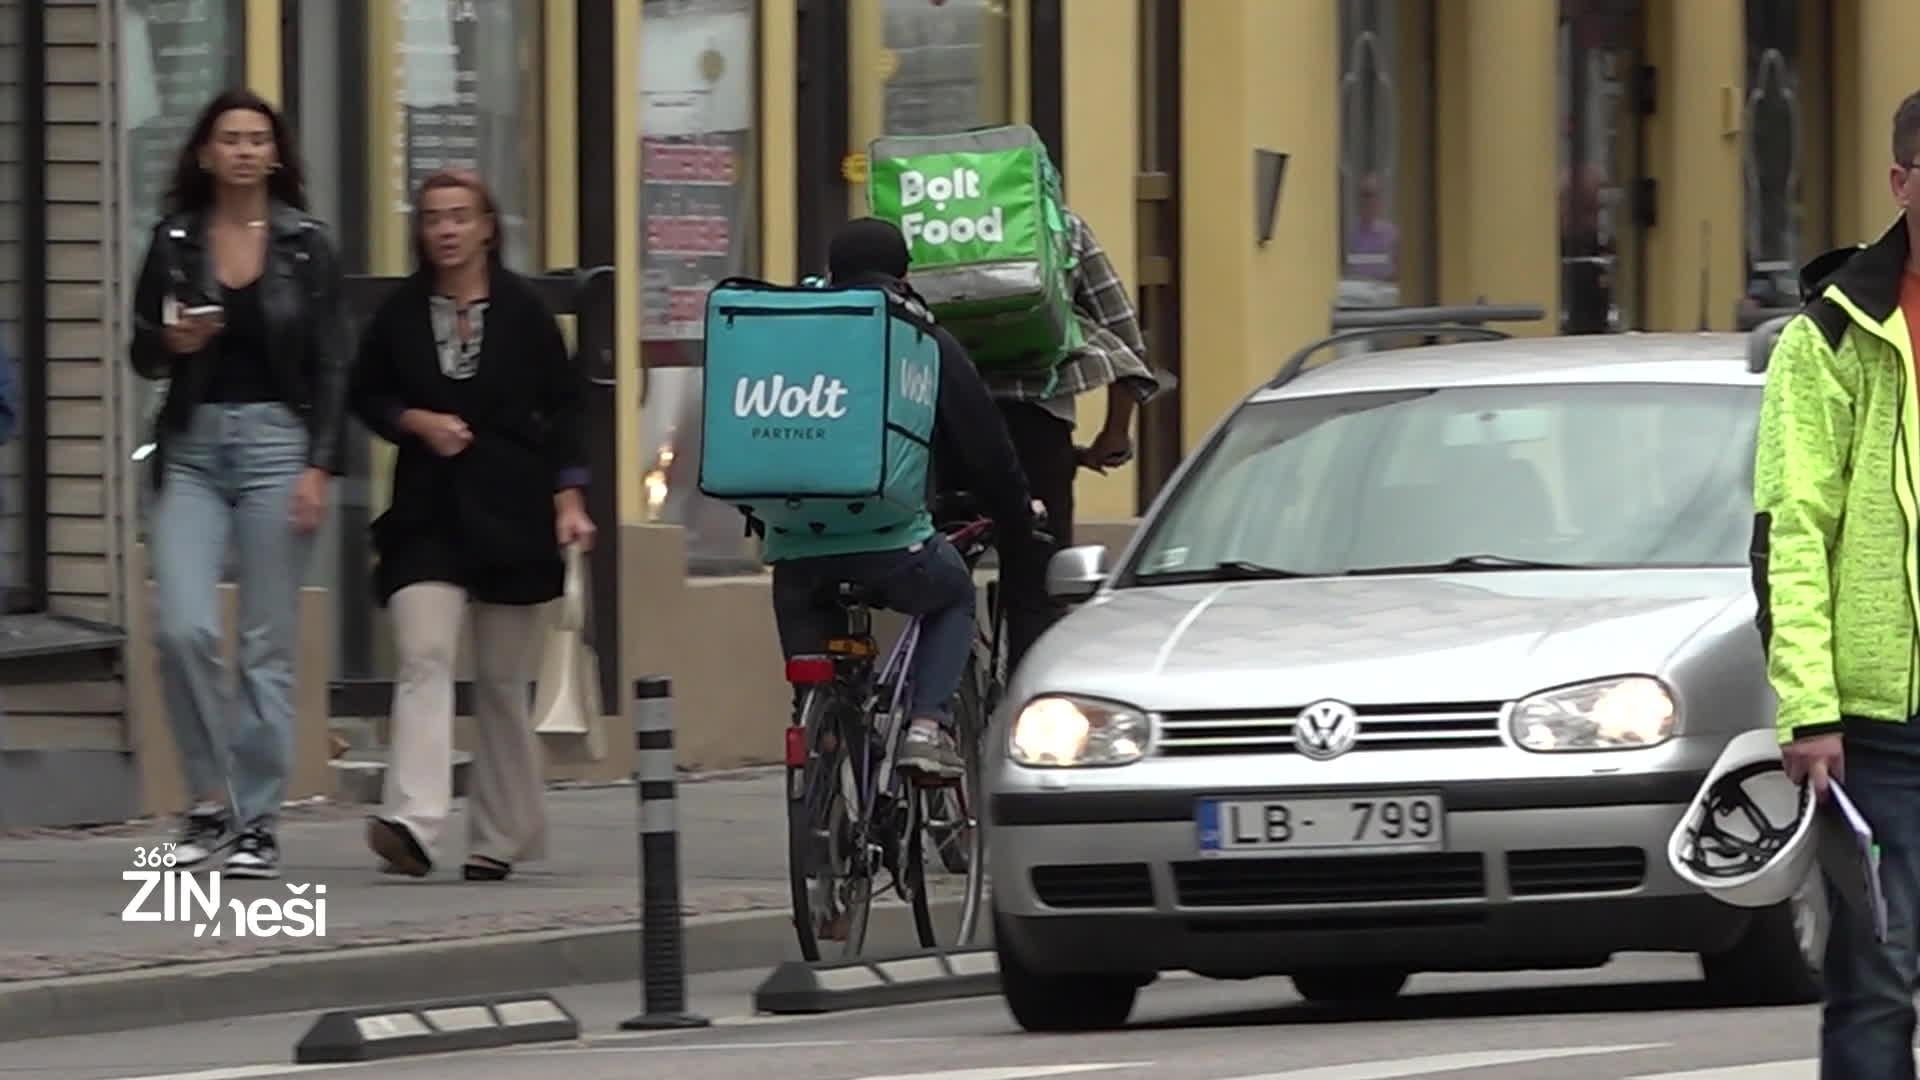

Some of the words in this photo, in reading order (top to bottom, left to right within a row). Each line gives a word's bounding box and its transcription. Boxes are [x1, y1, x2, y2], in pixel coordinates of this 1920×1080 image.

[900, 168, 980, 211] Bolt
[902, 206, 1003, 250] Food
[734, 374, 848, 418] Wolt
[752, 427, 826, 440] PARTNER
[1351, 800, 1433, 841] 799
